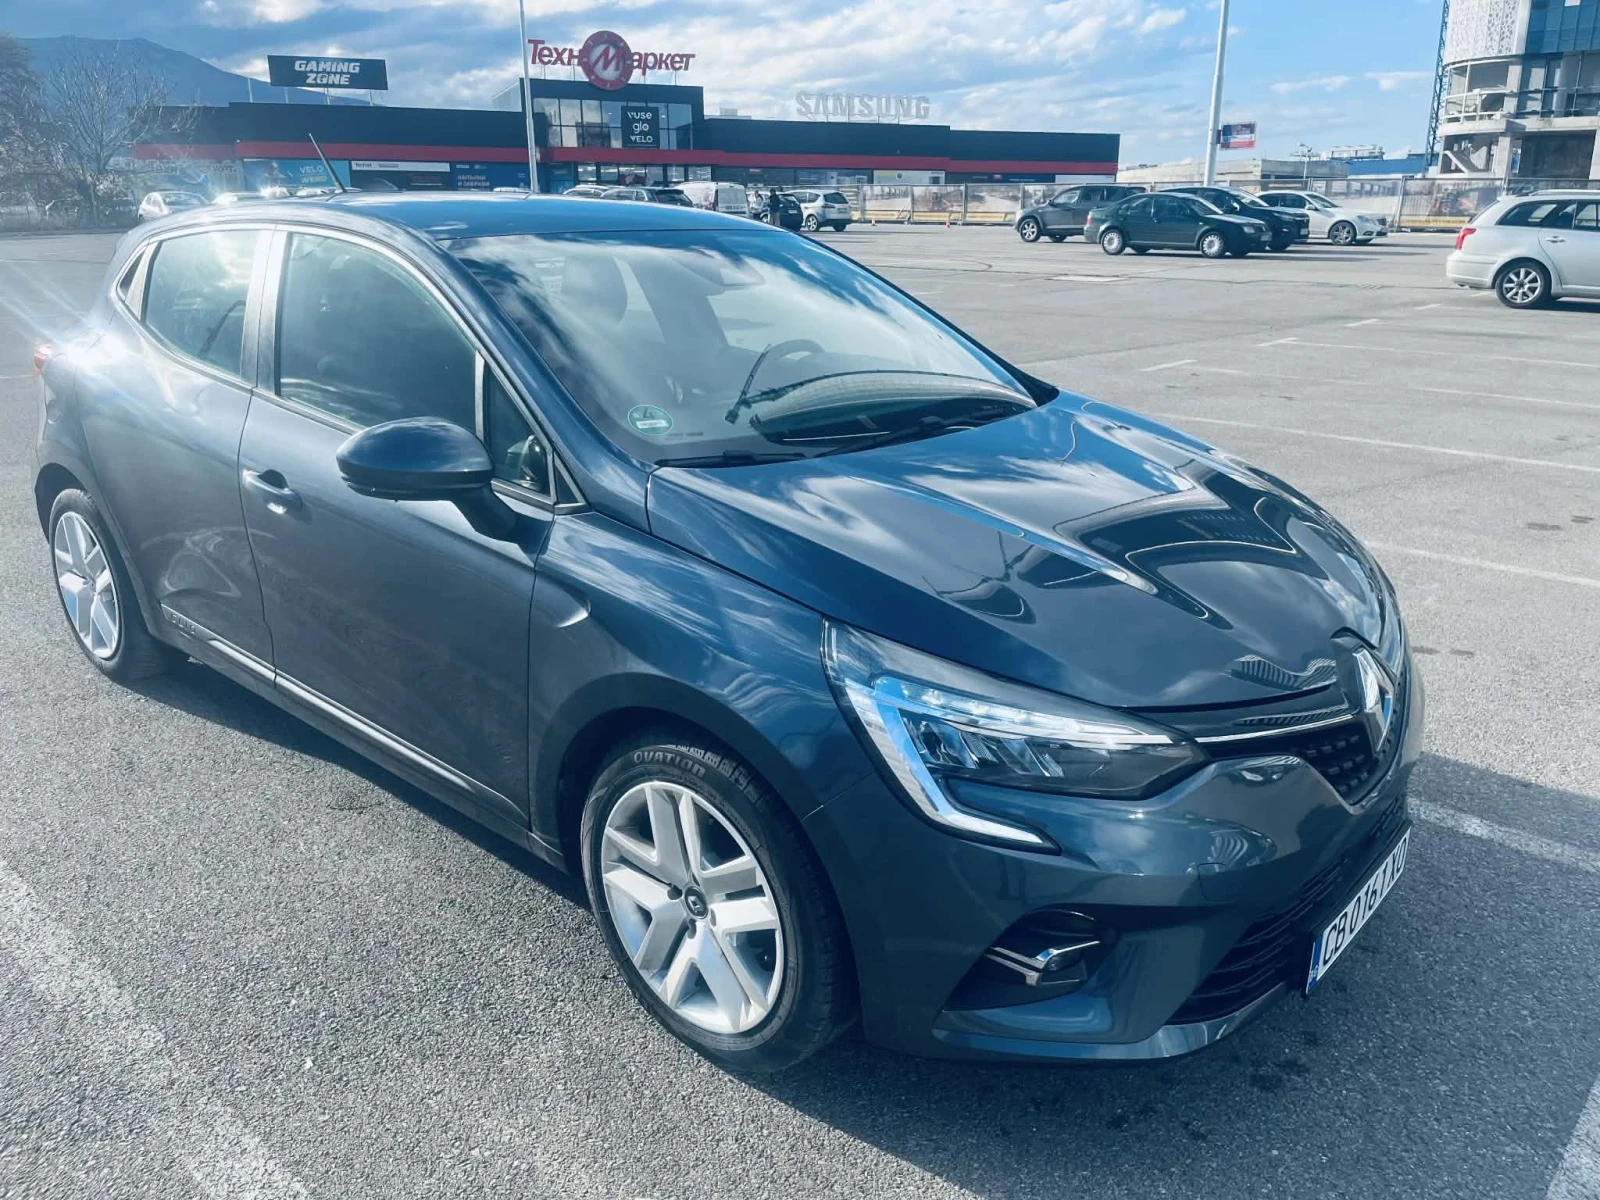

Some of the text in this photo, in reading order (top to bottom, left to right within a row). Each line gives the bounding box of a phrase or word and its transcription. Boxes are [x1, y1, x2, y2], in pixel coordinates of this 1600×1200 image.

[294, 60, 361, 73] GAMING
[305, 73, 351, 85] ZONE
[796, 90, 931, 119] SAMSUNG
[627, 111, 653, 120] vuse
[632, 120, 650, 134] glo
[630, 135, 654, 143] VELO
[299, 165, 324, 174] VELO
[634, 751, 706, 777] OVATION
[1323, 911, 1348, 967] CB
[1350, 864, 1388, 936] 0161
